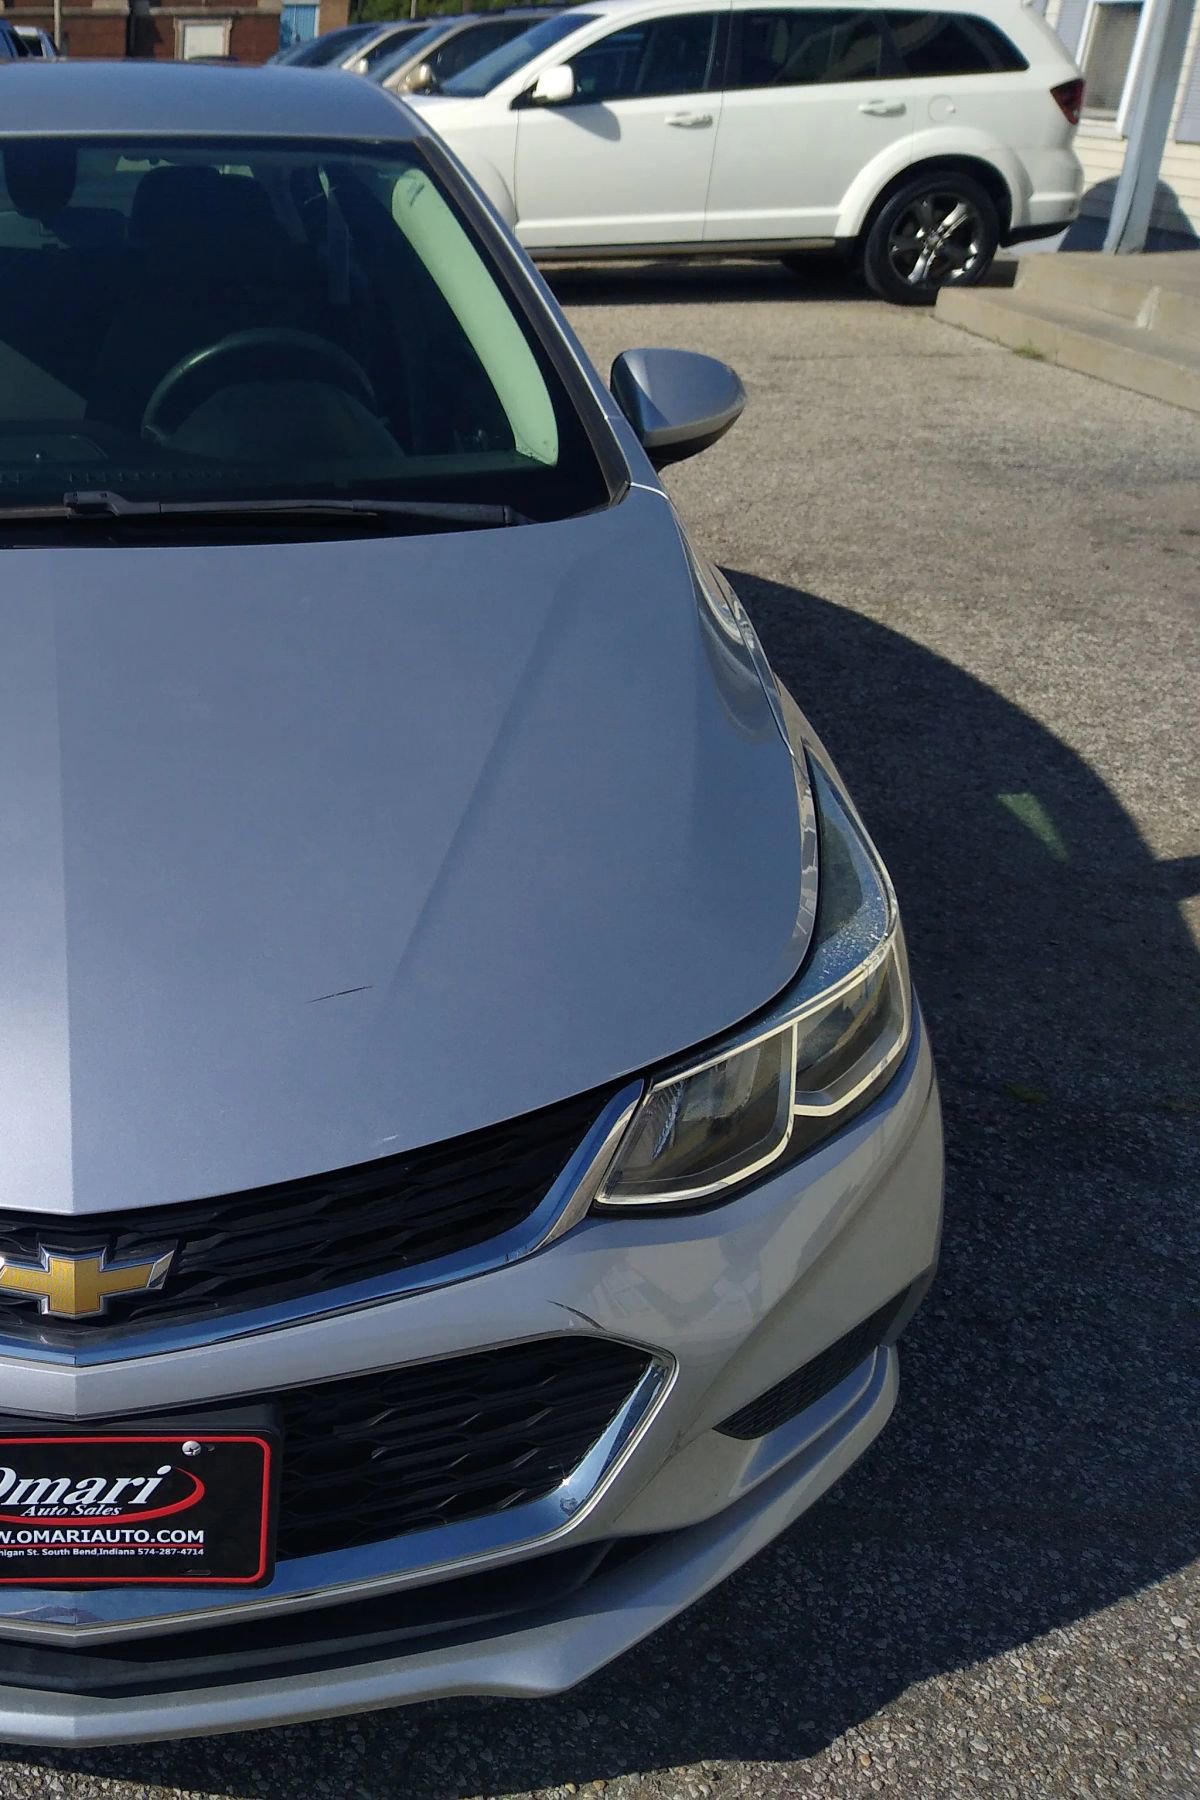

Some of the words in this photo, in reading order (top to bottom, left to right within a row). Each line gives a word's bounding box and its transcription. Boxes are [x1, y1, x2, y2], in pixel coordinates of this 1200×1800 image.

[20, 1505, 69, 1517] Auto
[71, 1504, 122, 1516] Sales
[41, 1548, 70, 1556] South
[137, 1548, 204, 1556] 574-287-4714
